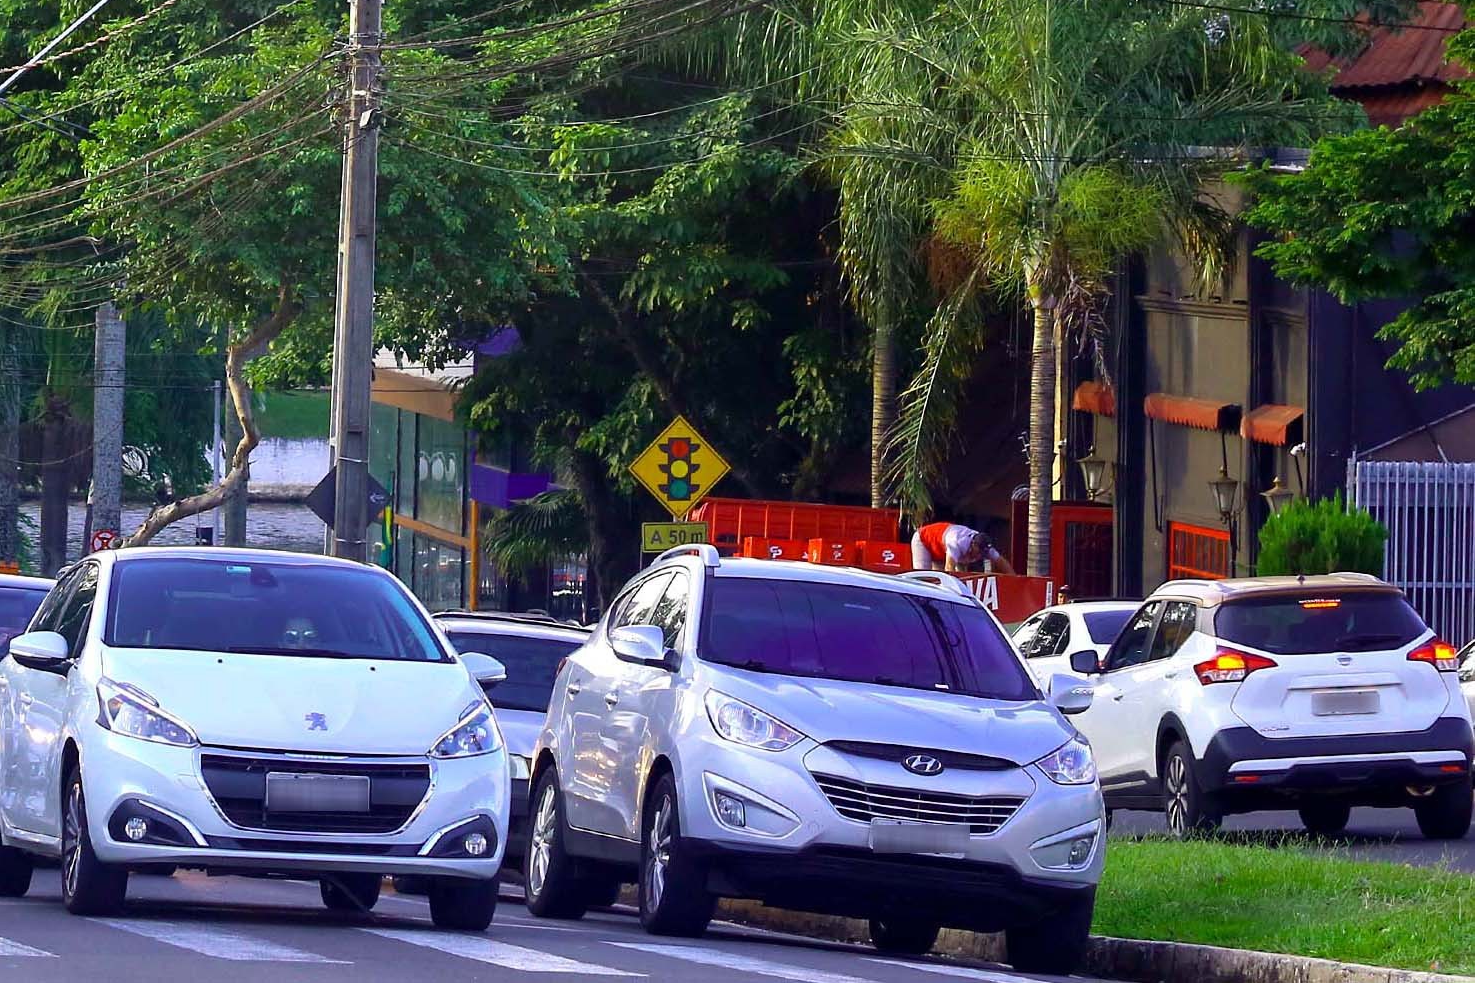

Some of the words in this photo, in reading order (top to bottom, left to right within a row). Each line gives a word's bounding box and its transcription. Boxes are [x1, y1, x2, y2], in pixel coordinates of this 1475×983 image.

[651, 529, 662, 544] A
[669, 530, 686, 544] 50
[691, 532, 703, 543] m
